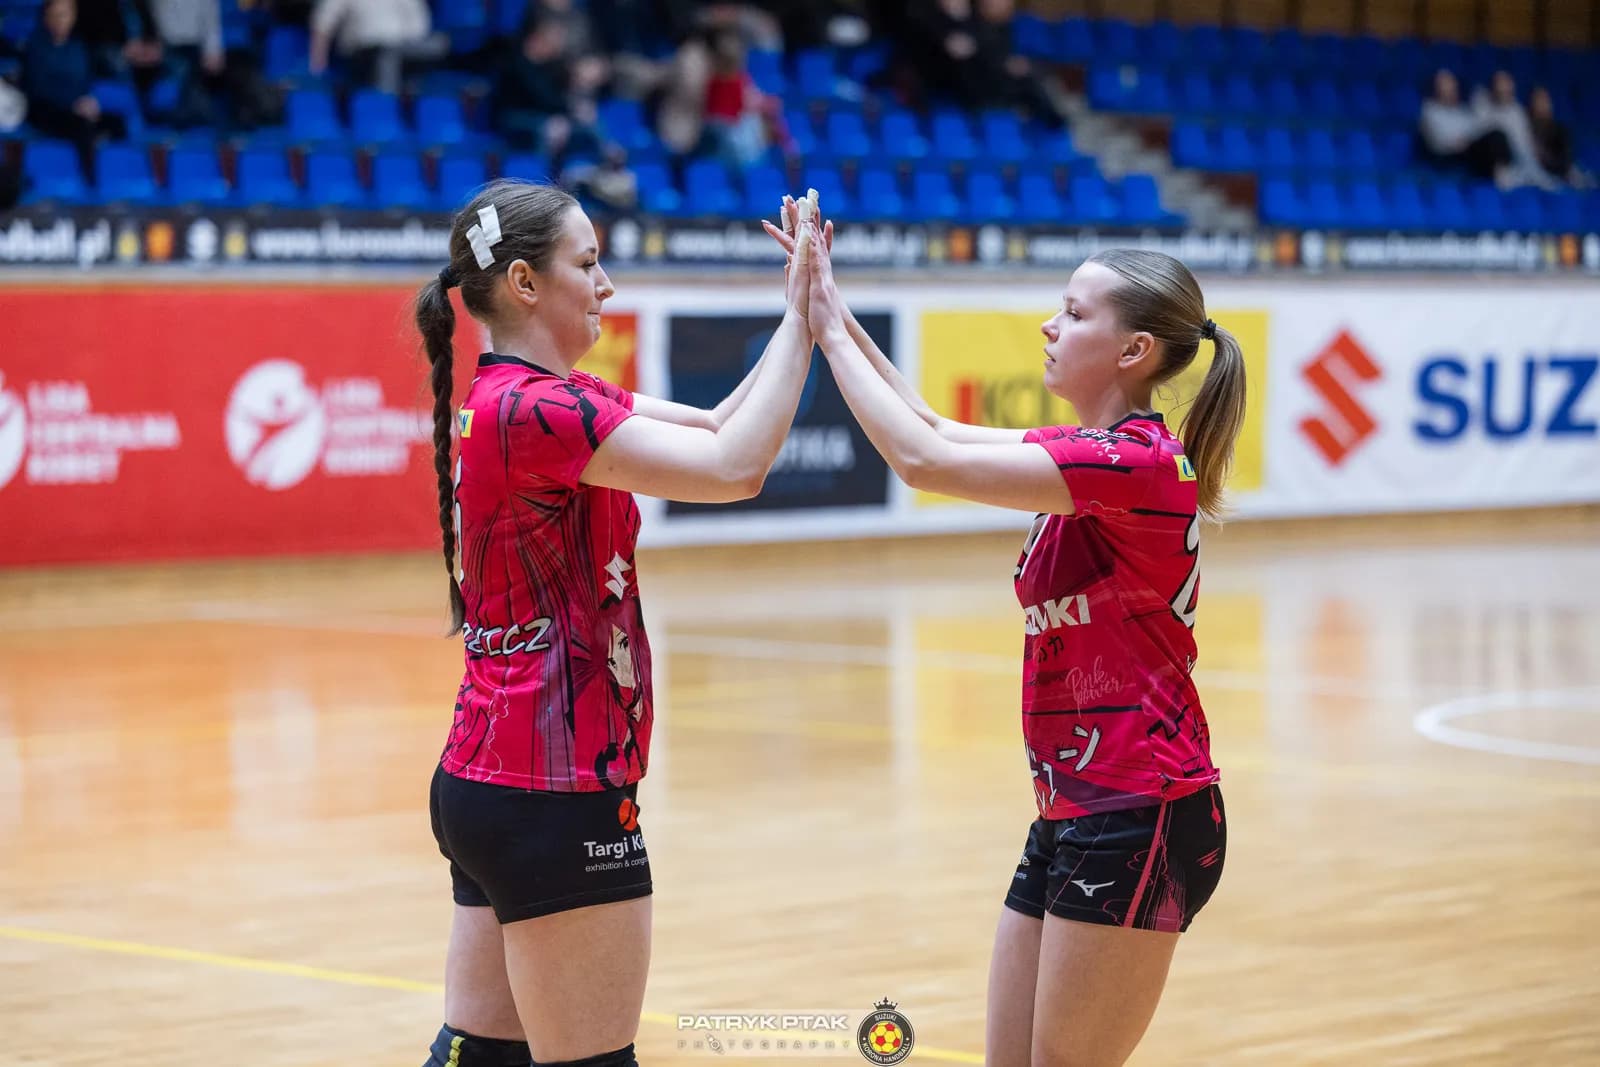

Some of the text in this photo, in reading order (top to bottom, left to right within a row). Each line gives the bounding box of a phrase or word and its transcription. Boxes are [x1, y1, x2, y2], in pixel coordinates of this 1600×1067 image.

[1413, 355, 1600, 442] SUZ
[584, 837, 629, 859] Targi
[585, 861, 623, 872] exhibition
[625, 859, 630, 867] &
